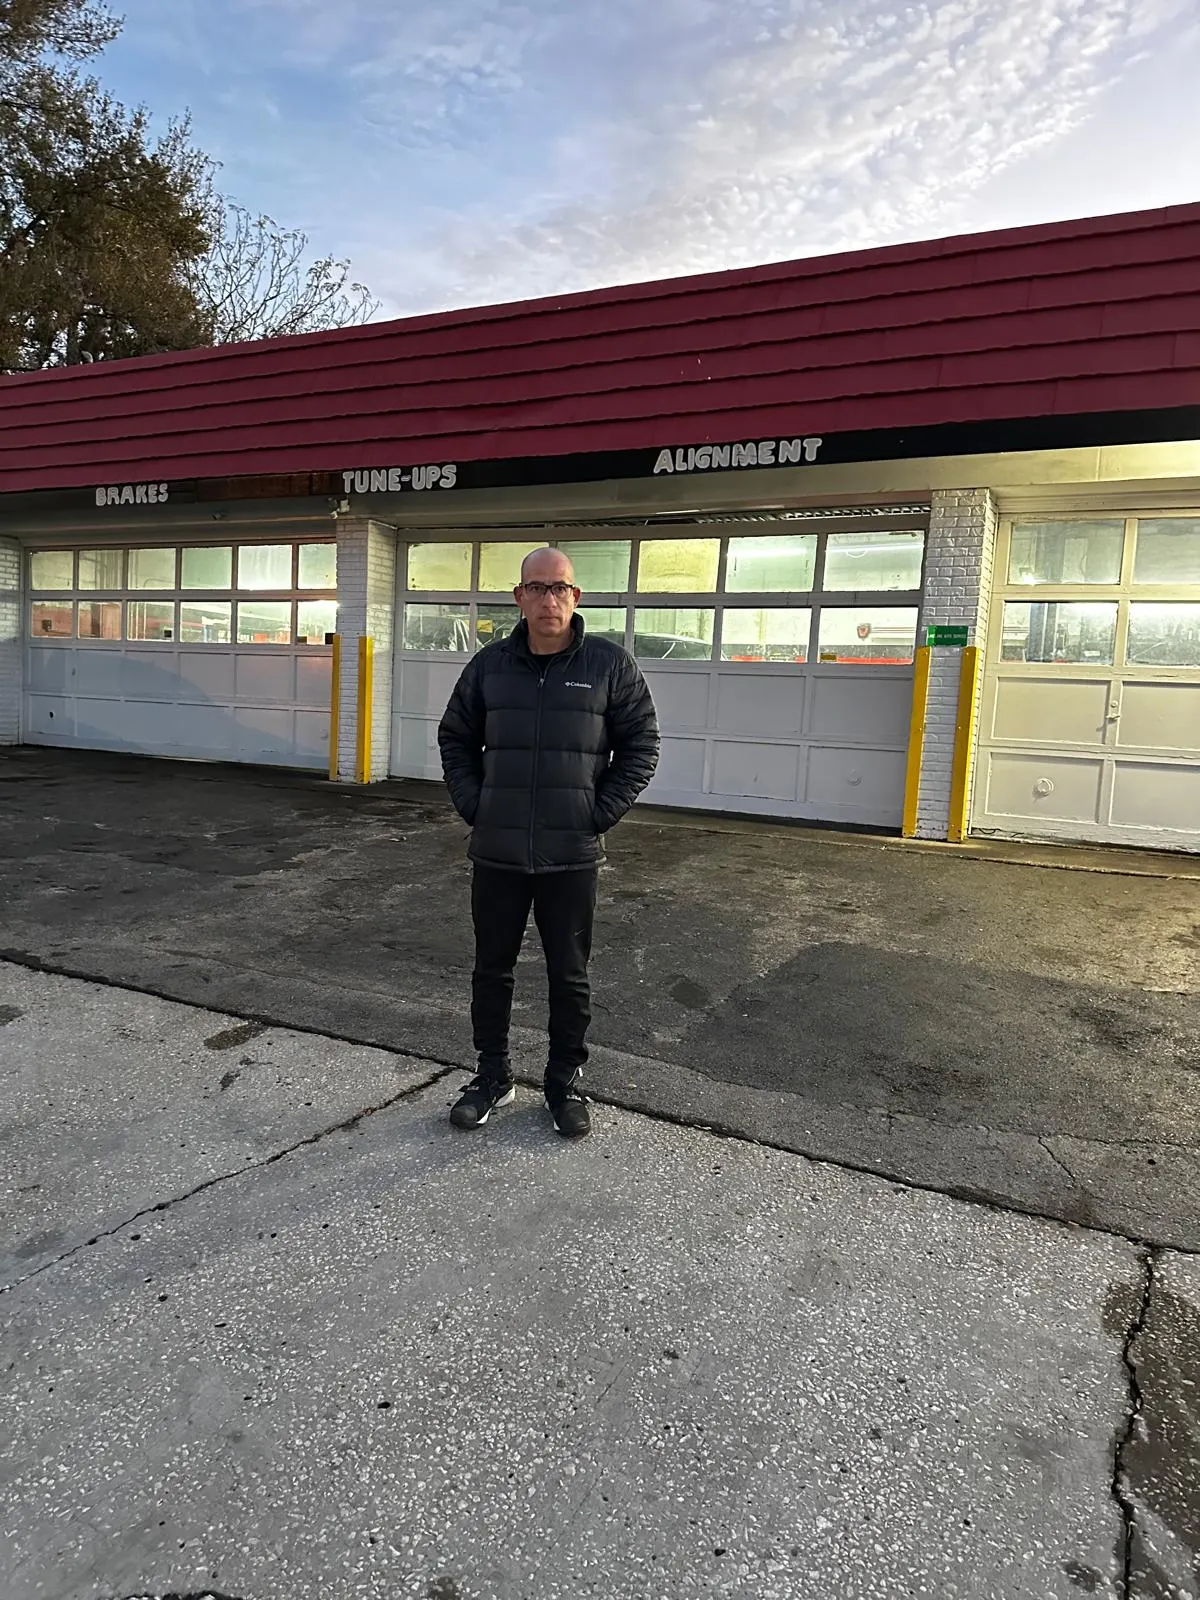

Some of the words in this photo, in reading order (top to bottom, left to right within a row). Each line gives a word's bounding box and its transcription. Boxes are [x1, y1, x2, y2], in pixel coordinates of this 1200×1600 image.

[653, 437, 823, 473] ALIGNMENT
[342, 464, 457, 493] TUNE-UPS
[95, 483, 169, 506] BRAKES
